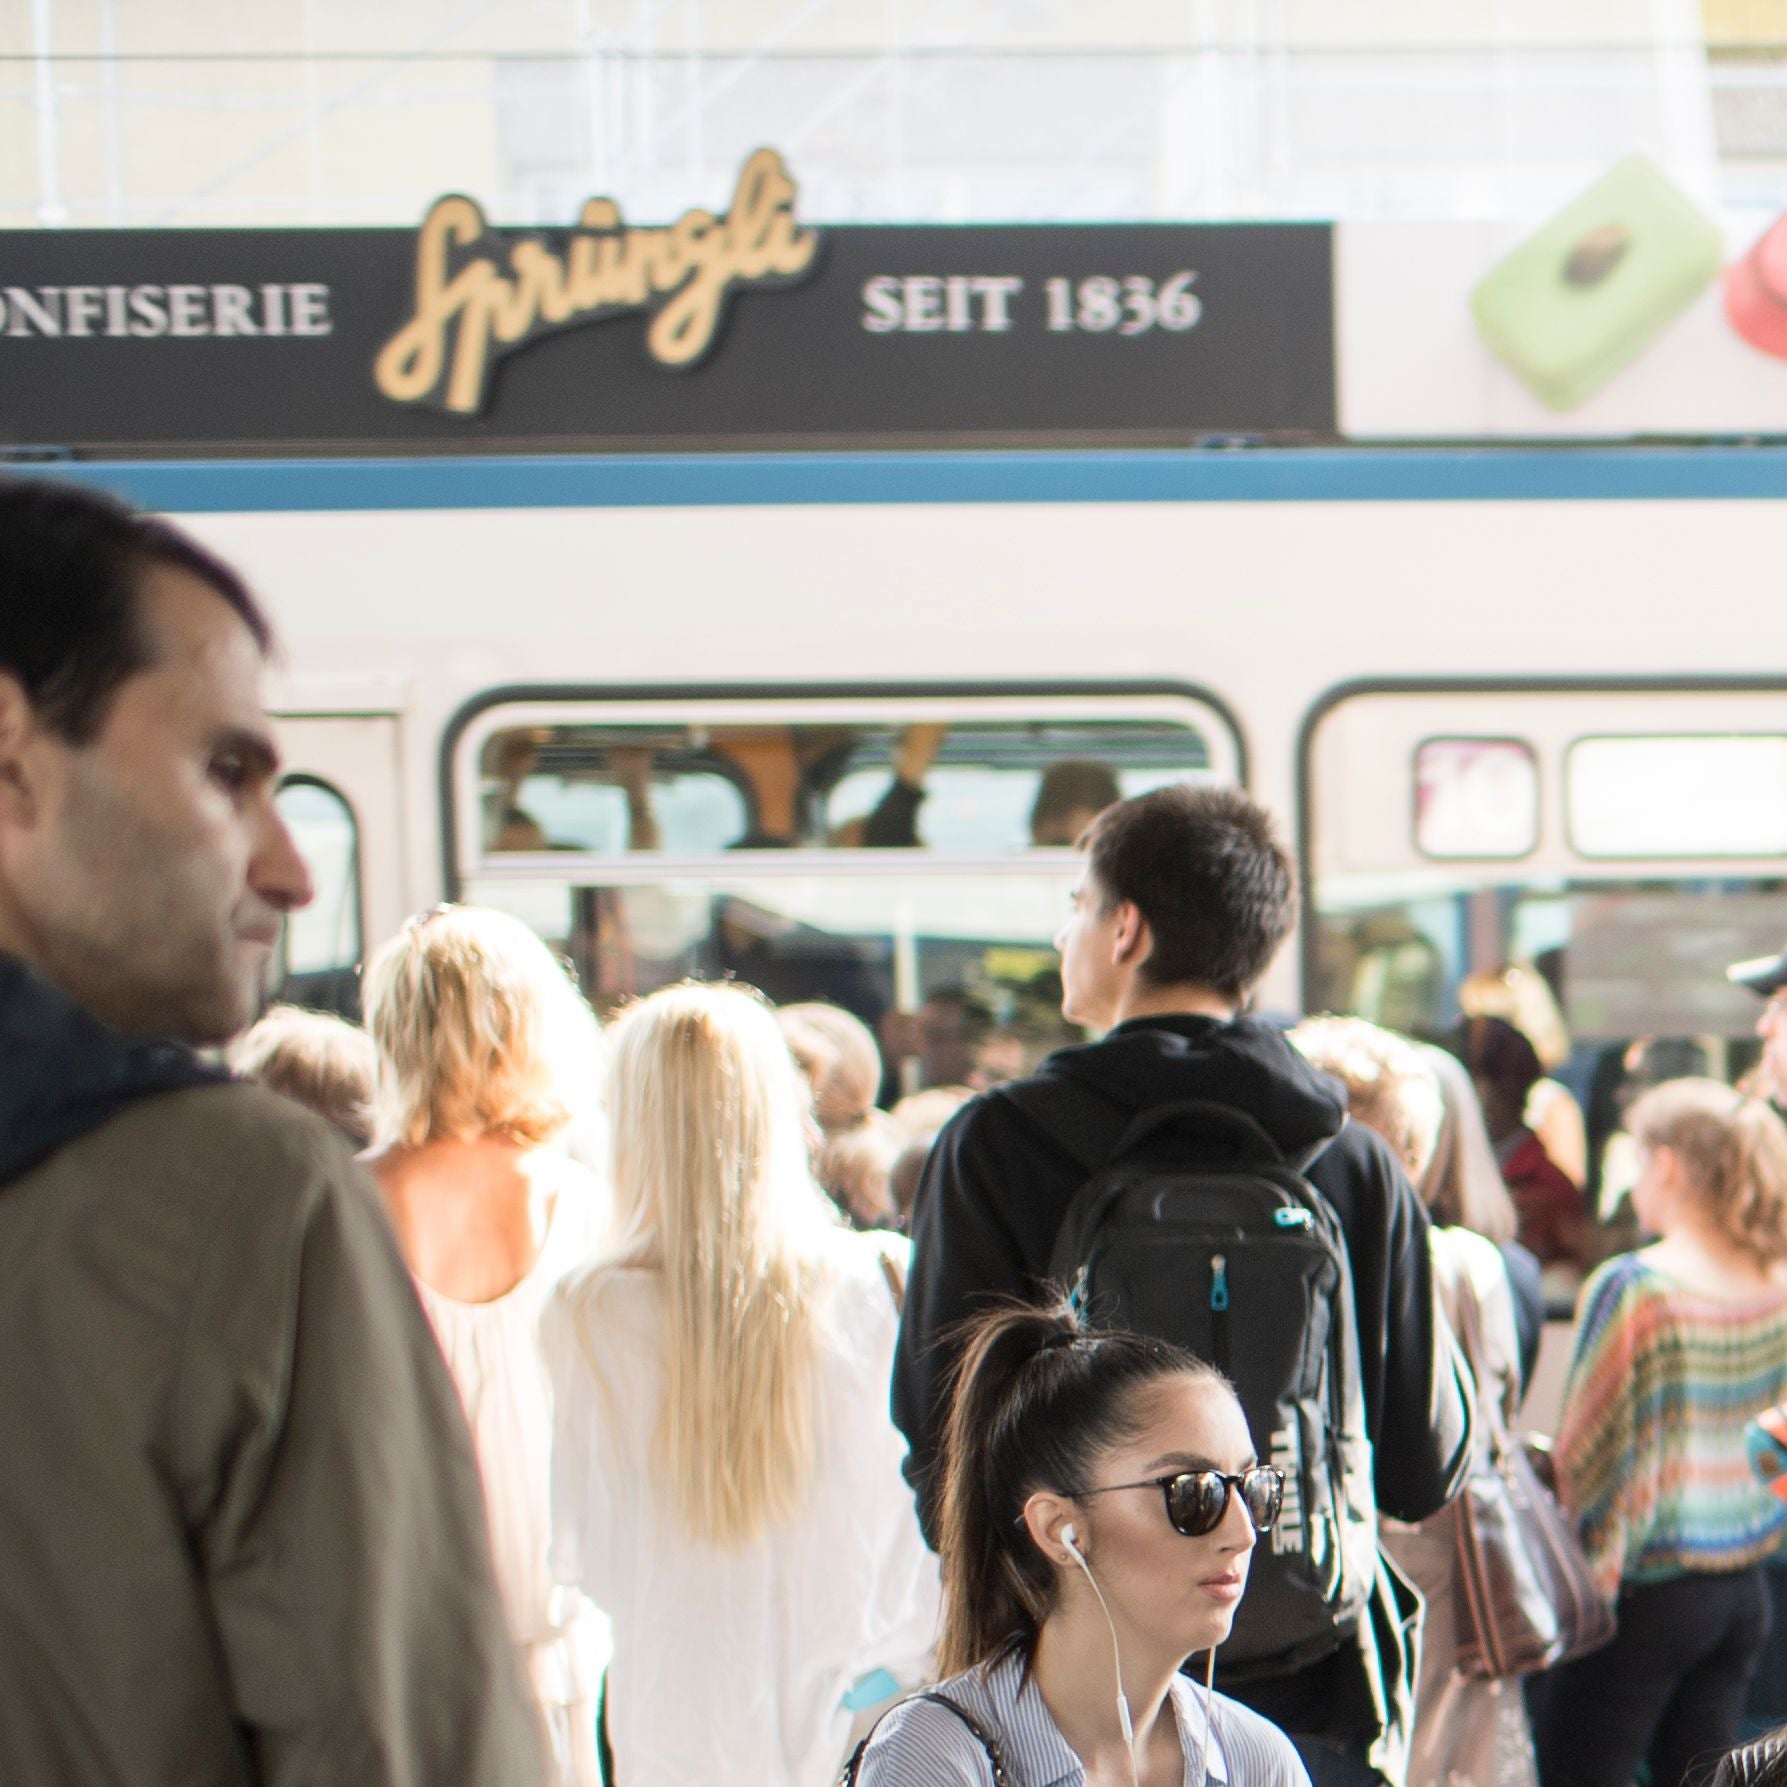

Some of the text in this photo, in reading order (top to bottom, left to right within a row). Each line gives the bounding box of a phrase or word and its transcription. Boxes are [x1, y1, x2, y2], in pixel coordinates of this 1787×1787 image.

[0, 282, 334, 338] NFISERIE
[861, 274, 1024, 333] SEIT
[1046, 269, 1202, 336] 1836
